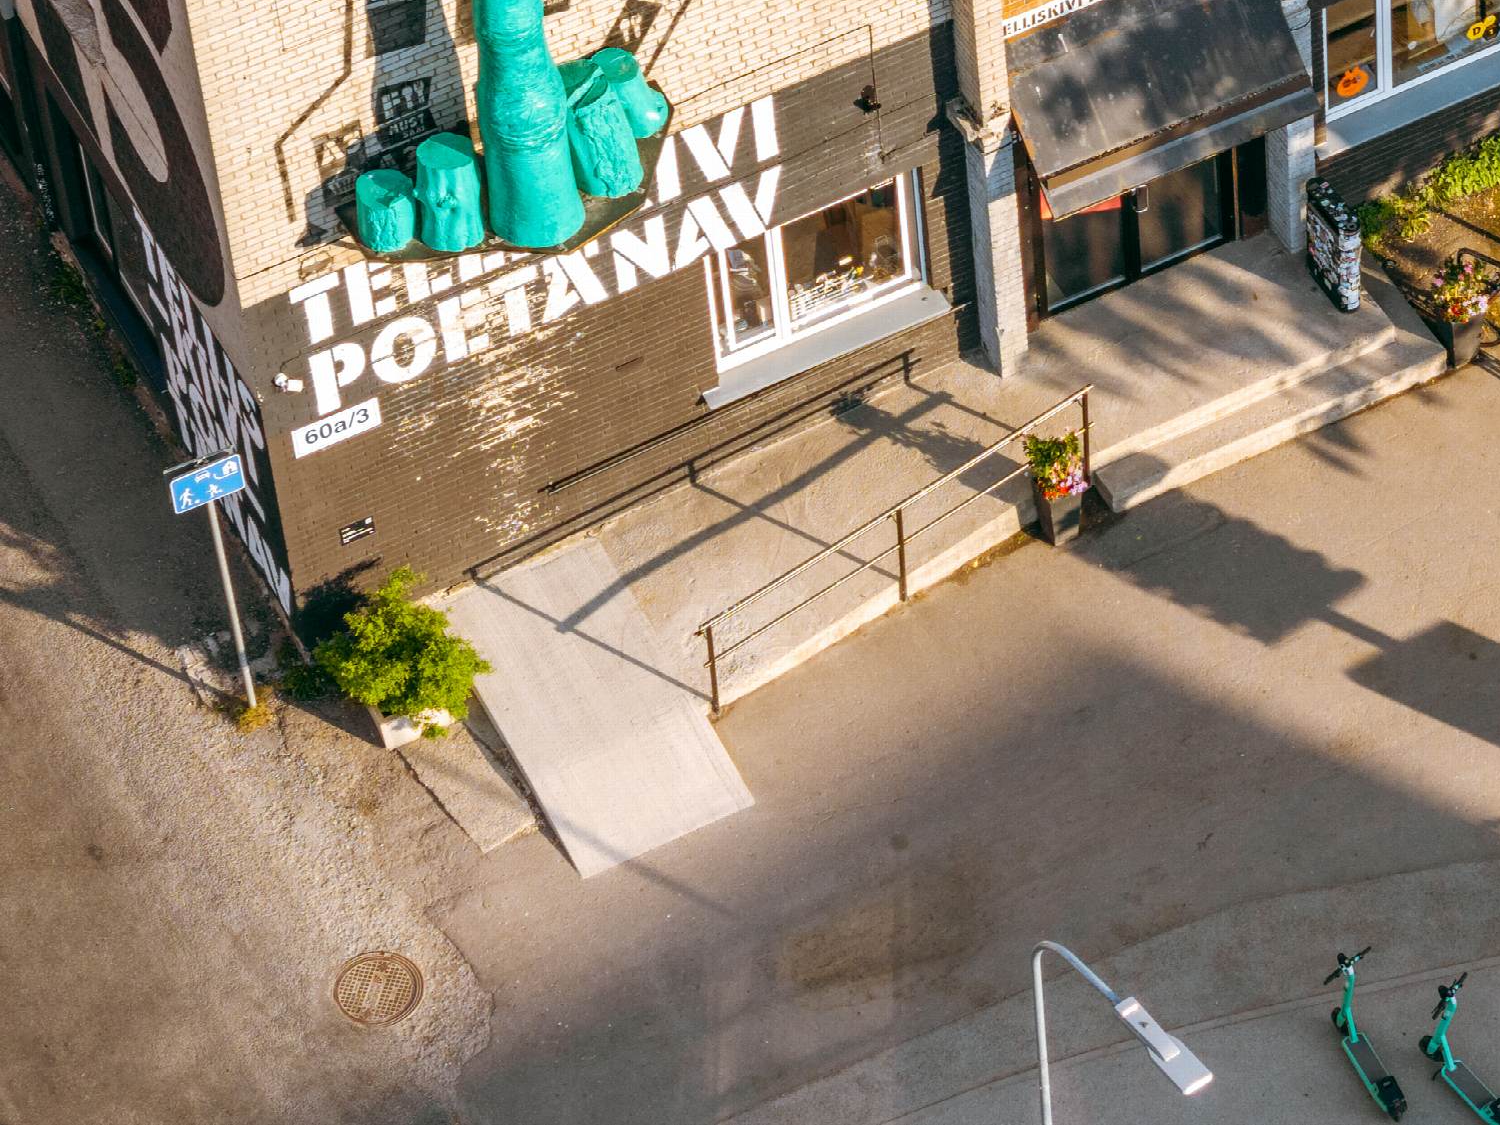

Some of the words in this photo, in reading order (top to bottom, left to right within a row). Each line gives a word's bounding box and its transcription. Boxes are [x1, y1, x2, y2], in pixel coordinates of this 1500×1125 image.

[390, 113, 425, 136] MUST
[308, 165, 783, 417] POETÄNAV
[304, 408, 370, 444] 60a/3
